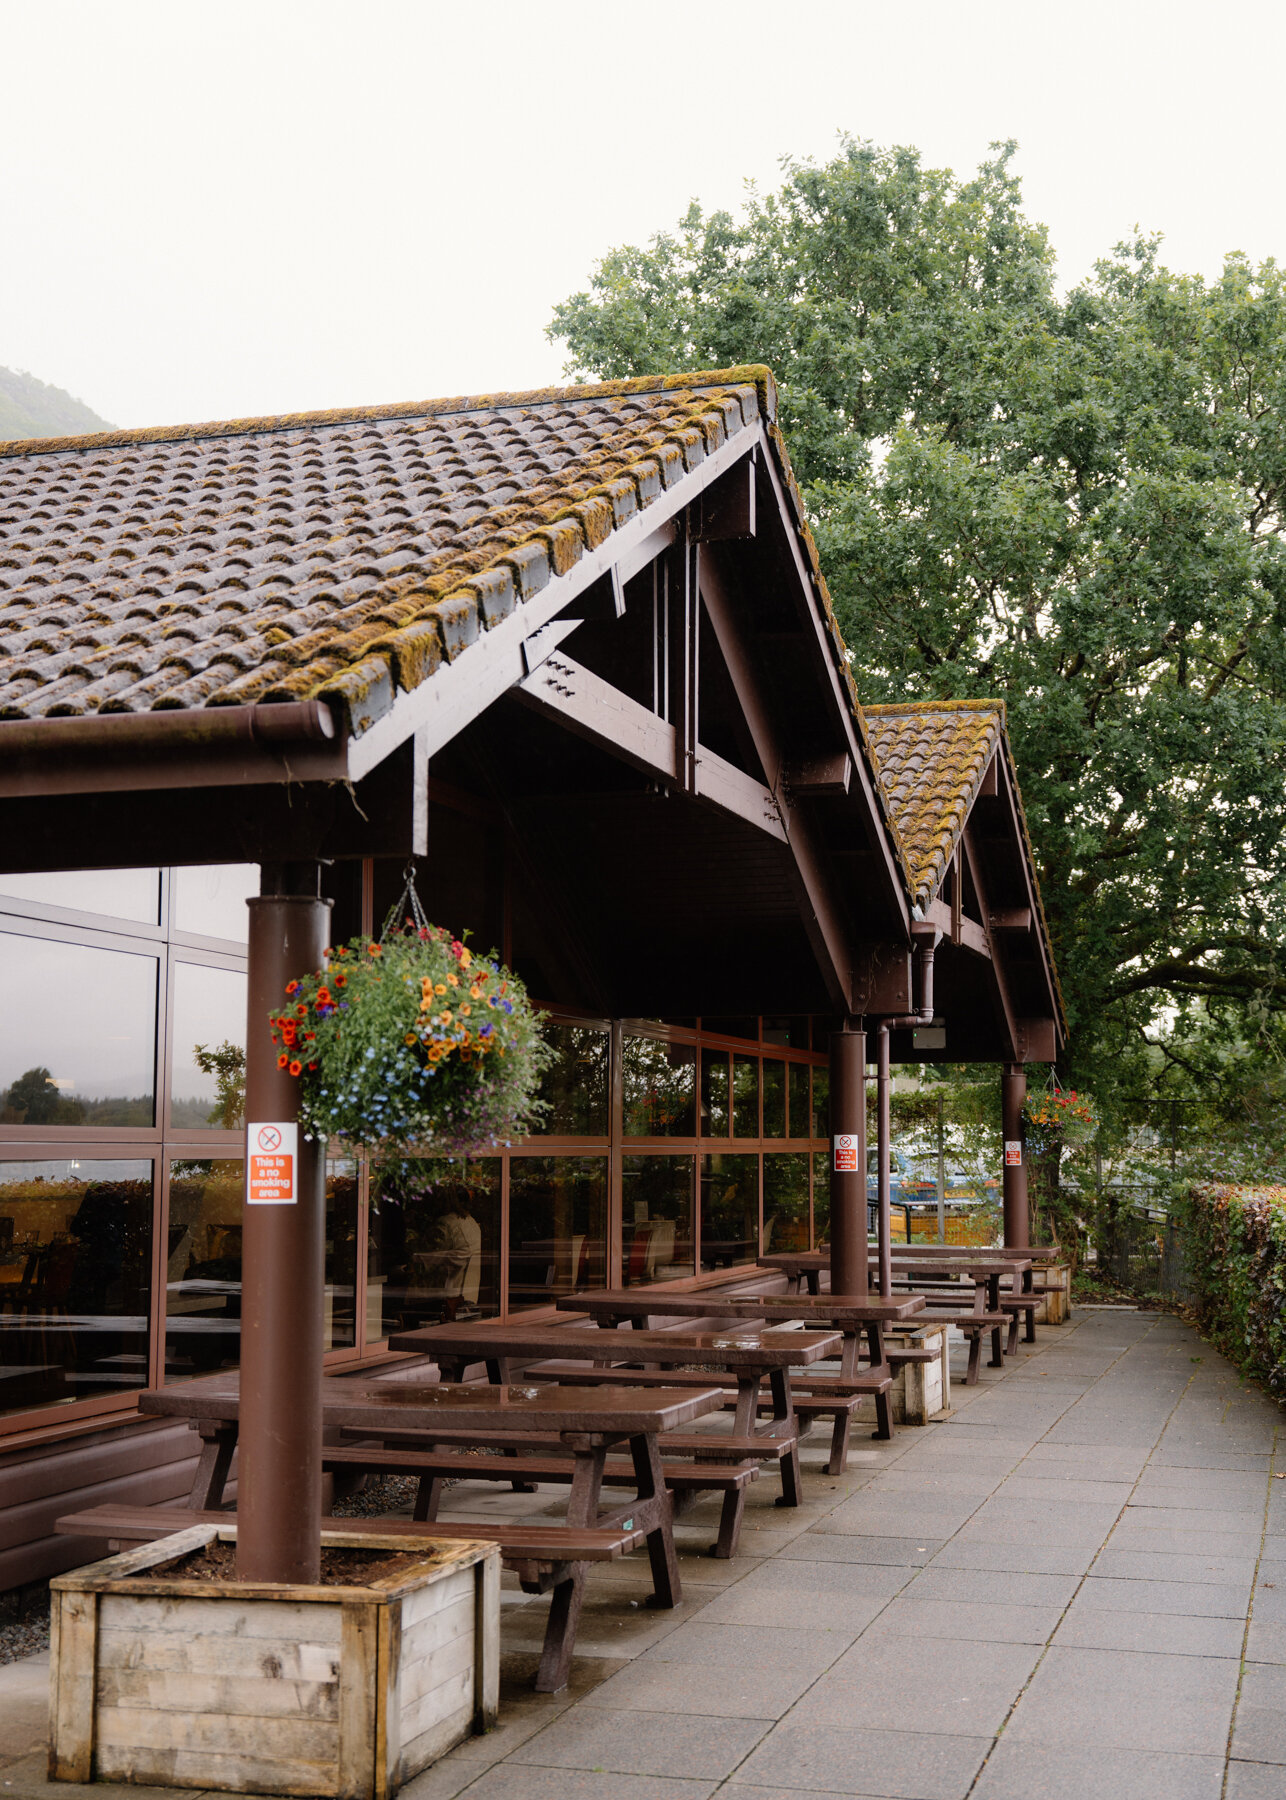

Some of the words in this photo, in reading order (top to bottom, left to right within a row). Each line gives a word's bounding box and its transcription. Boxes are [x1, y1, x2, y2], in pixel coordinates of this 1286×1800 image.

[255, 1157, 274, 1167] This
[275, 1157, 285, 1167] is
[259, 1169, 265, 1177] a
[266, 1169, 279, 1177] no
[252, 1178, 290, 1189] smoking
[259, 1189, 280, 1197] area
